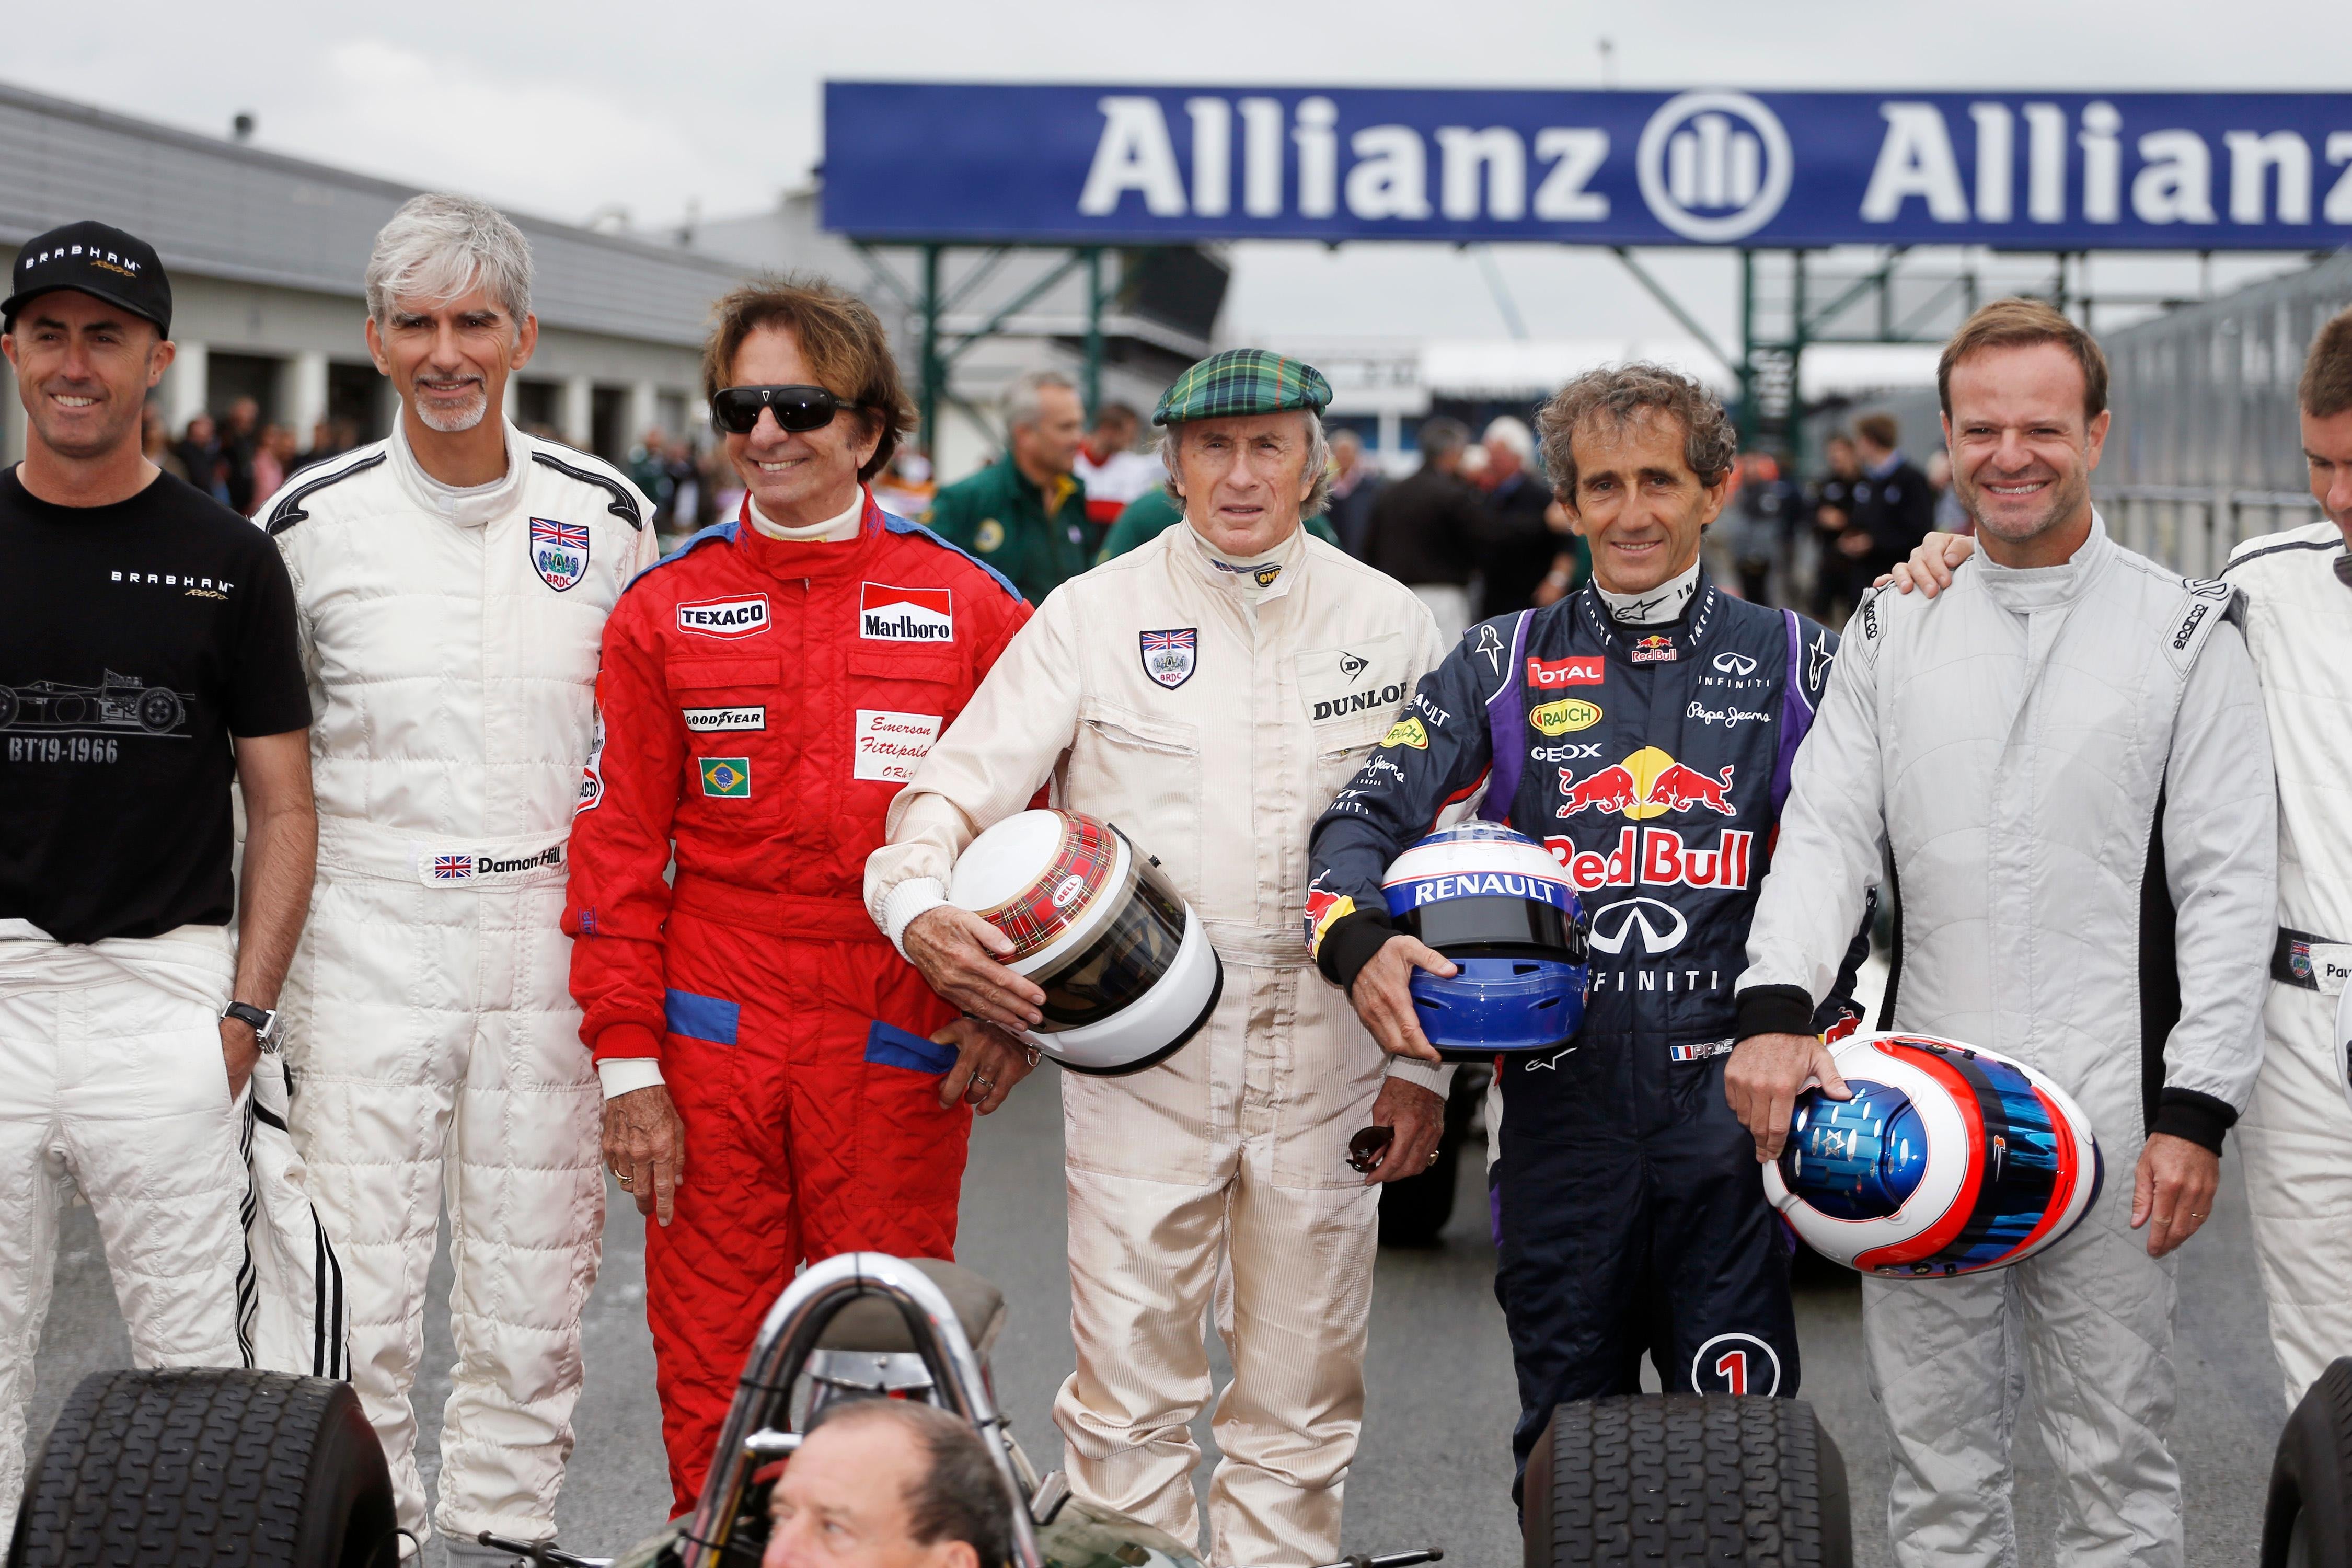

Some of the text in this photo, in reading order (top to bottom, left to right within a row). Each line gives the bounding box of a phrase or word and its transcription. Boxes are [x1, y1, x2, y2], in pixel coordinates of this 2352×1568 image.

[1078, 96, 1611, 222] Allianz
[547, 573, 571, 587] BRDC
[185, 589, 229, 601] Retro
[682, 605, 763, 626] TEXACO
[865, 615, 950, 638] Marlboro
[1160, 672, 1182, 682] BRDC
[1530, 663, 1601, 684] TOTAL
[1698, 675, 1770, 689] INFINITI
[1313, 682, 1407, 720] DUNLOP
[1543, 708, 1592, 727] RAUCH
[1686, 701, 1771, 728] Pepe Jeans
[871, 717, 931, 735] Emerson
[9, 737, 118, 764] BT19-1966
[860, 736, 931, 759] Fittipald
[1531, 743, 1603, 762] GEOX
[478, 846, 560, 873] Damon Hill
[1639, 826, 1754, 890] Bull
[1057, 881, 1078, 902] BELL
[1415, 874, 1555, 907] RENAULT
[1593, 970, 1718, 992] FINITI
[1692, 1037, 1735, 1059] PROS
[1716, 1350, 1747, 1398] 1
